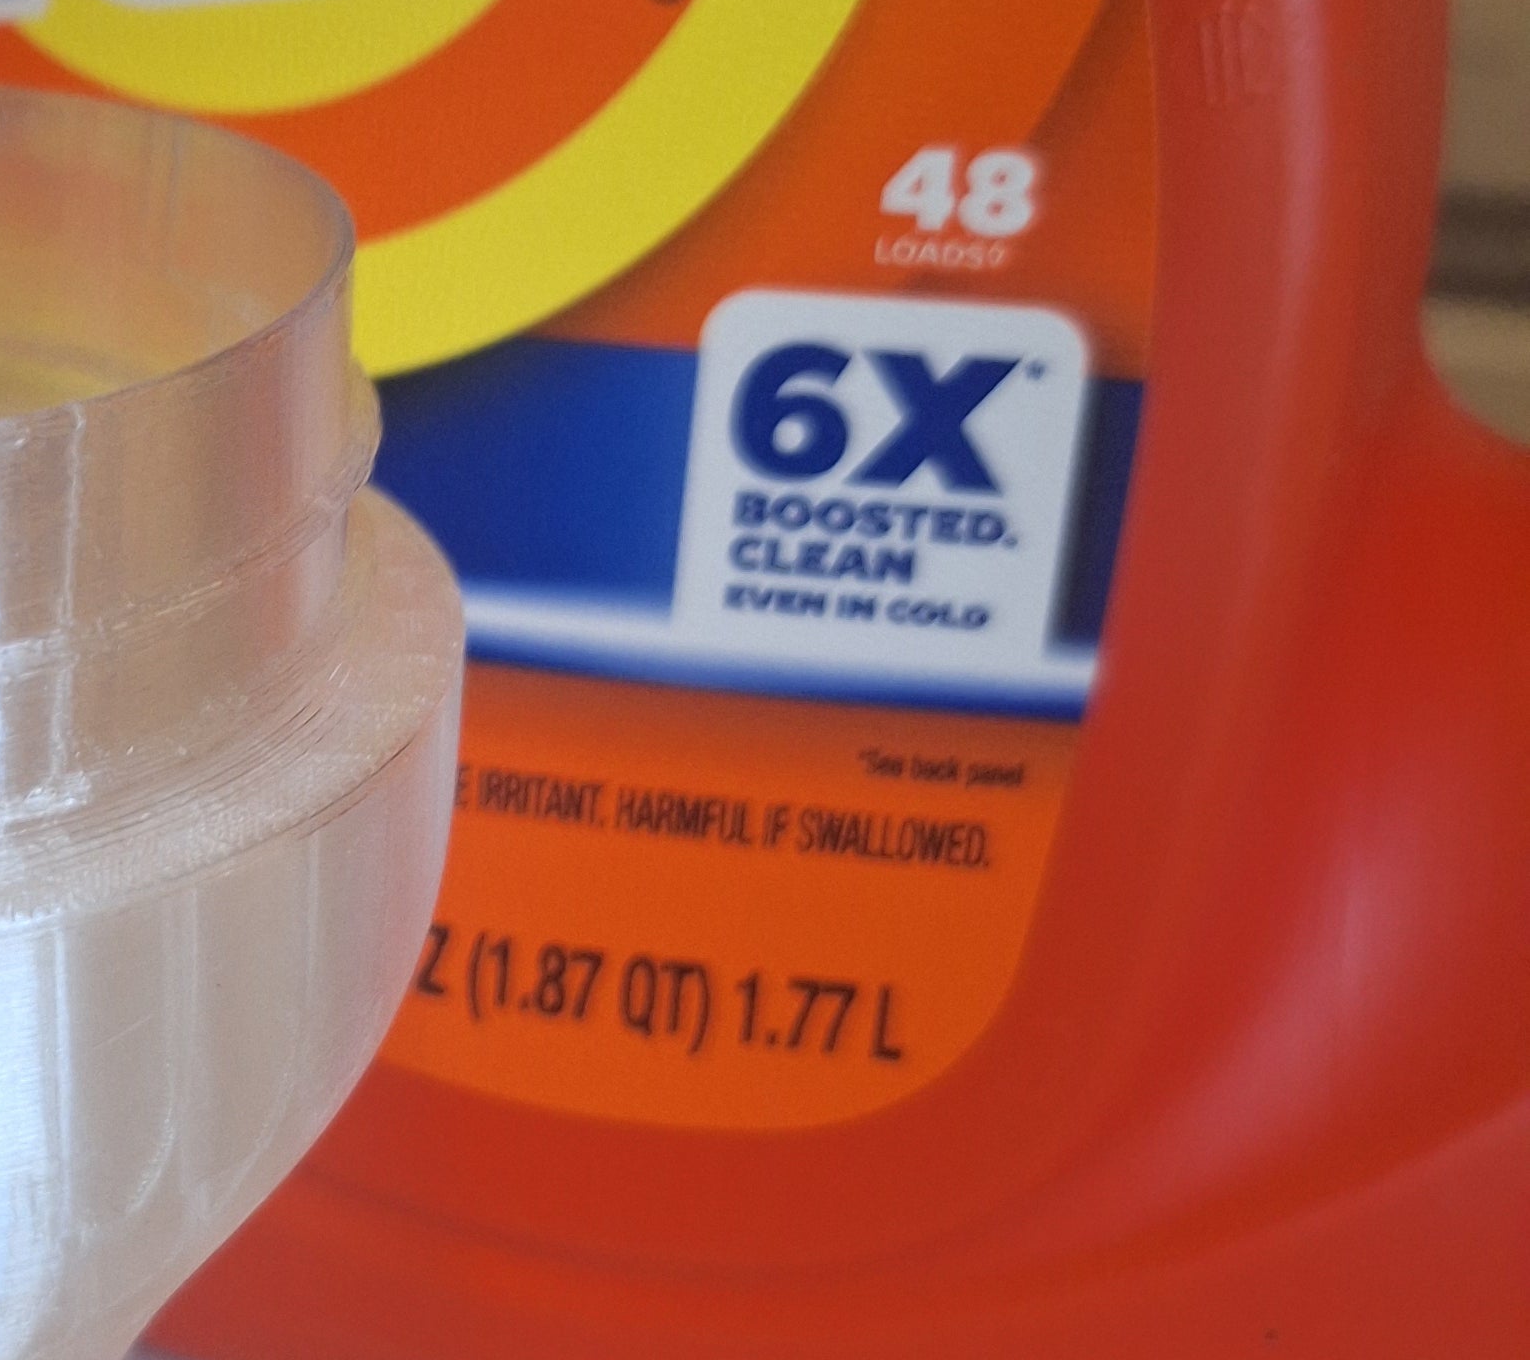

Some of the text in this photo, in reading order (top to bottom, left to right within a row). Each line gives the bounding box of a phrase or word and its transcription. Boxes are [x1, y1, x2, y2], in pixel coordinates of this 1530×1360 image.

[878, 147, 1037, 239] 48
[728, 537, 917, 585] CLEAN
[723, 586, 991, 629] EVEN IN COLD
[613, 785, 753, 847] HARMFUL
[762, 803, 790, 848] IF
[795, 808, 991, 867] SWALLOWED.
[415, 925, 903, 1061] Z (1.87 QT) 1.77 L
